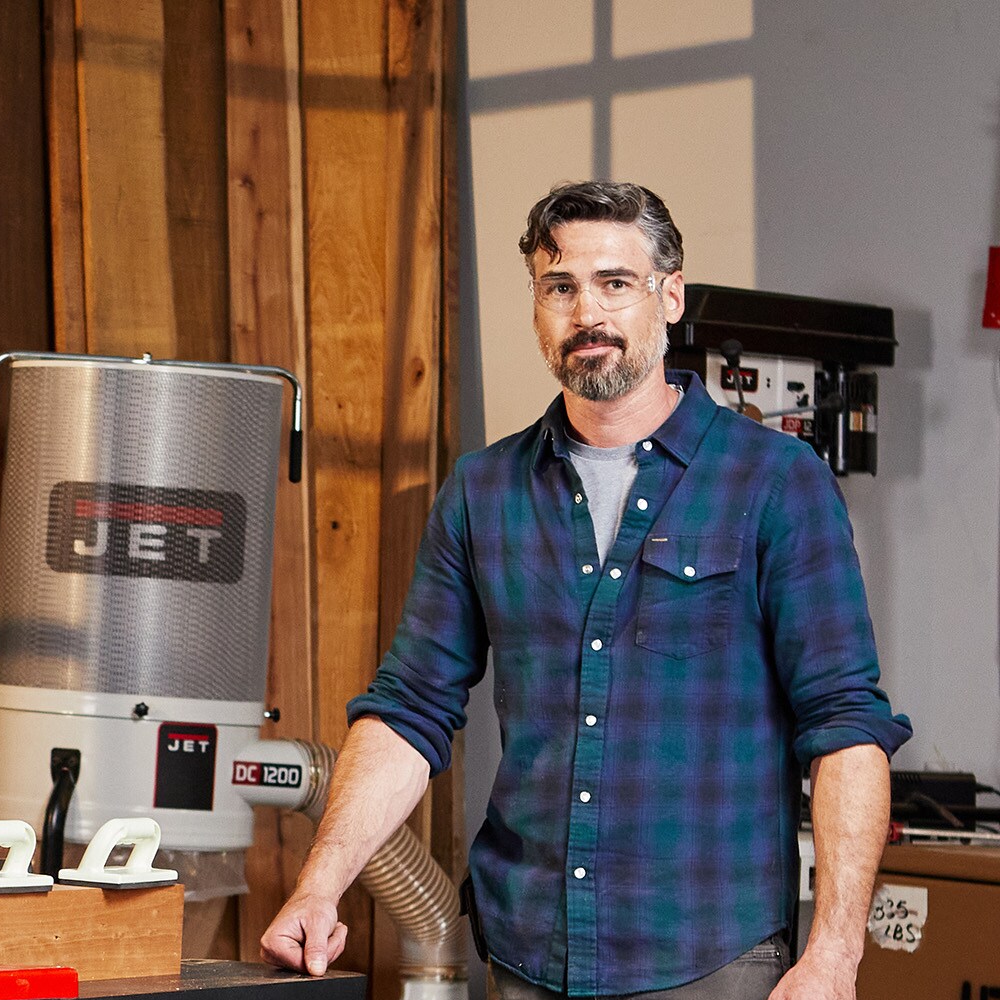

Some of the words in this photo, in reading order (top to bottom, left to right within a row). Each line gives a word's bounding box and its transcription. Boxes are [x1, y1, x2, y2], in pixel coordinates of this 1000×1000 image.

[74, 522, 221, 563] JET
[168, 740, 209, 752] JET
[235, 765, 257, 782] DC
[263, 766, 299, 784] 1200
[885, 924, 916, 943] LBS
